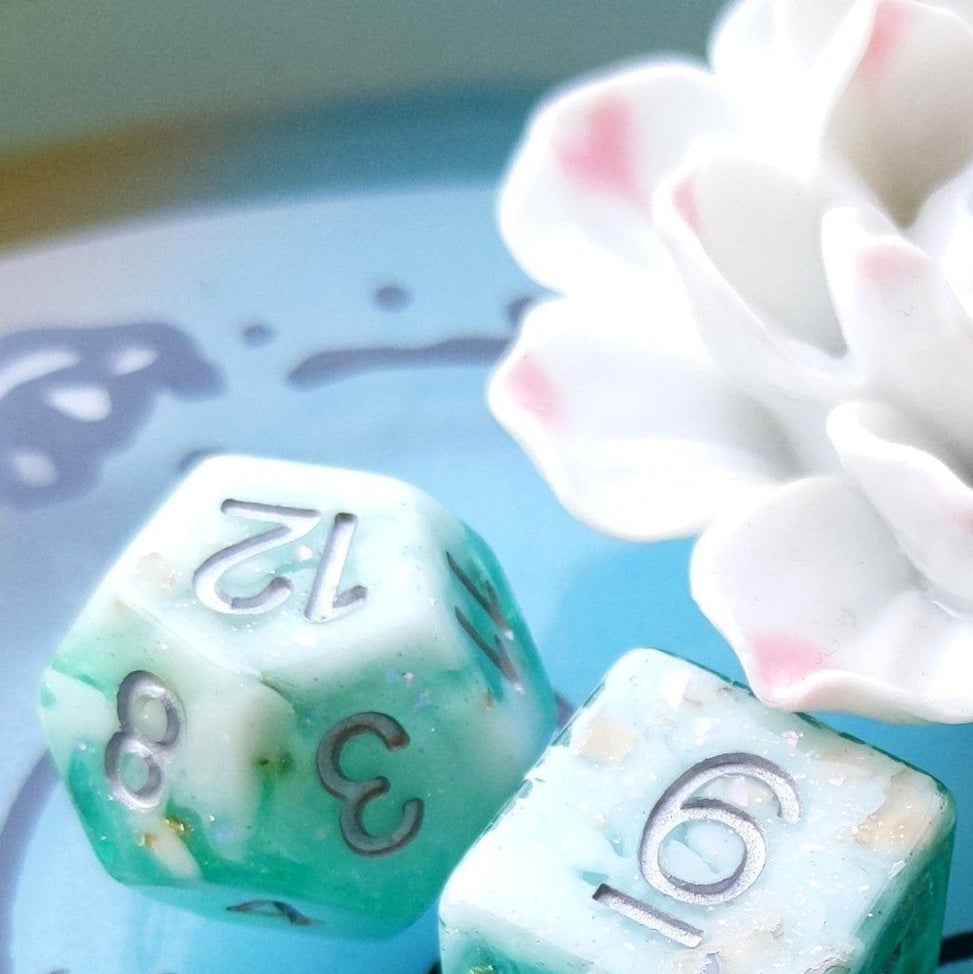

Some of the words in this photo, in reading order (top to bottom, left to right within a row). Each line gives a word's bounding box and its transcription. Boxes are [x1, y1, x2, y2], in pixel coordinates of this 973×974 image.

[193, 498, 367, 624] 12
[103, 669, 181, 812] 8
[316, 710, 426, 857] 3
